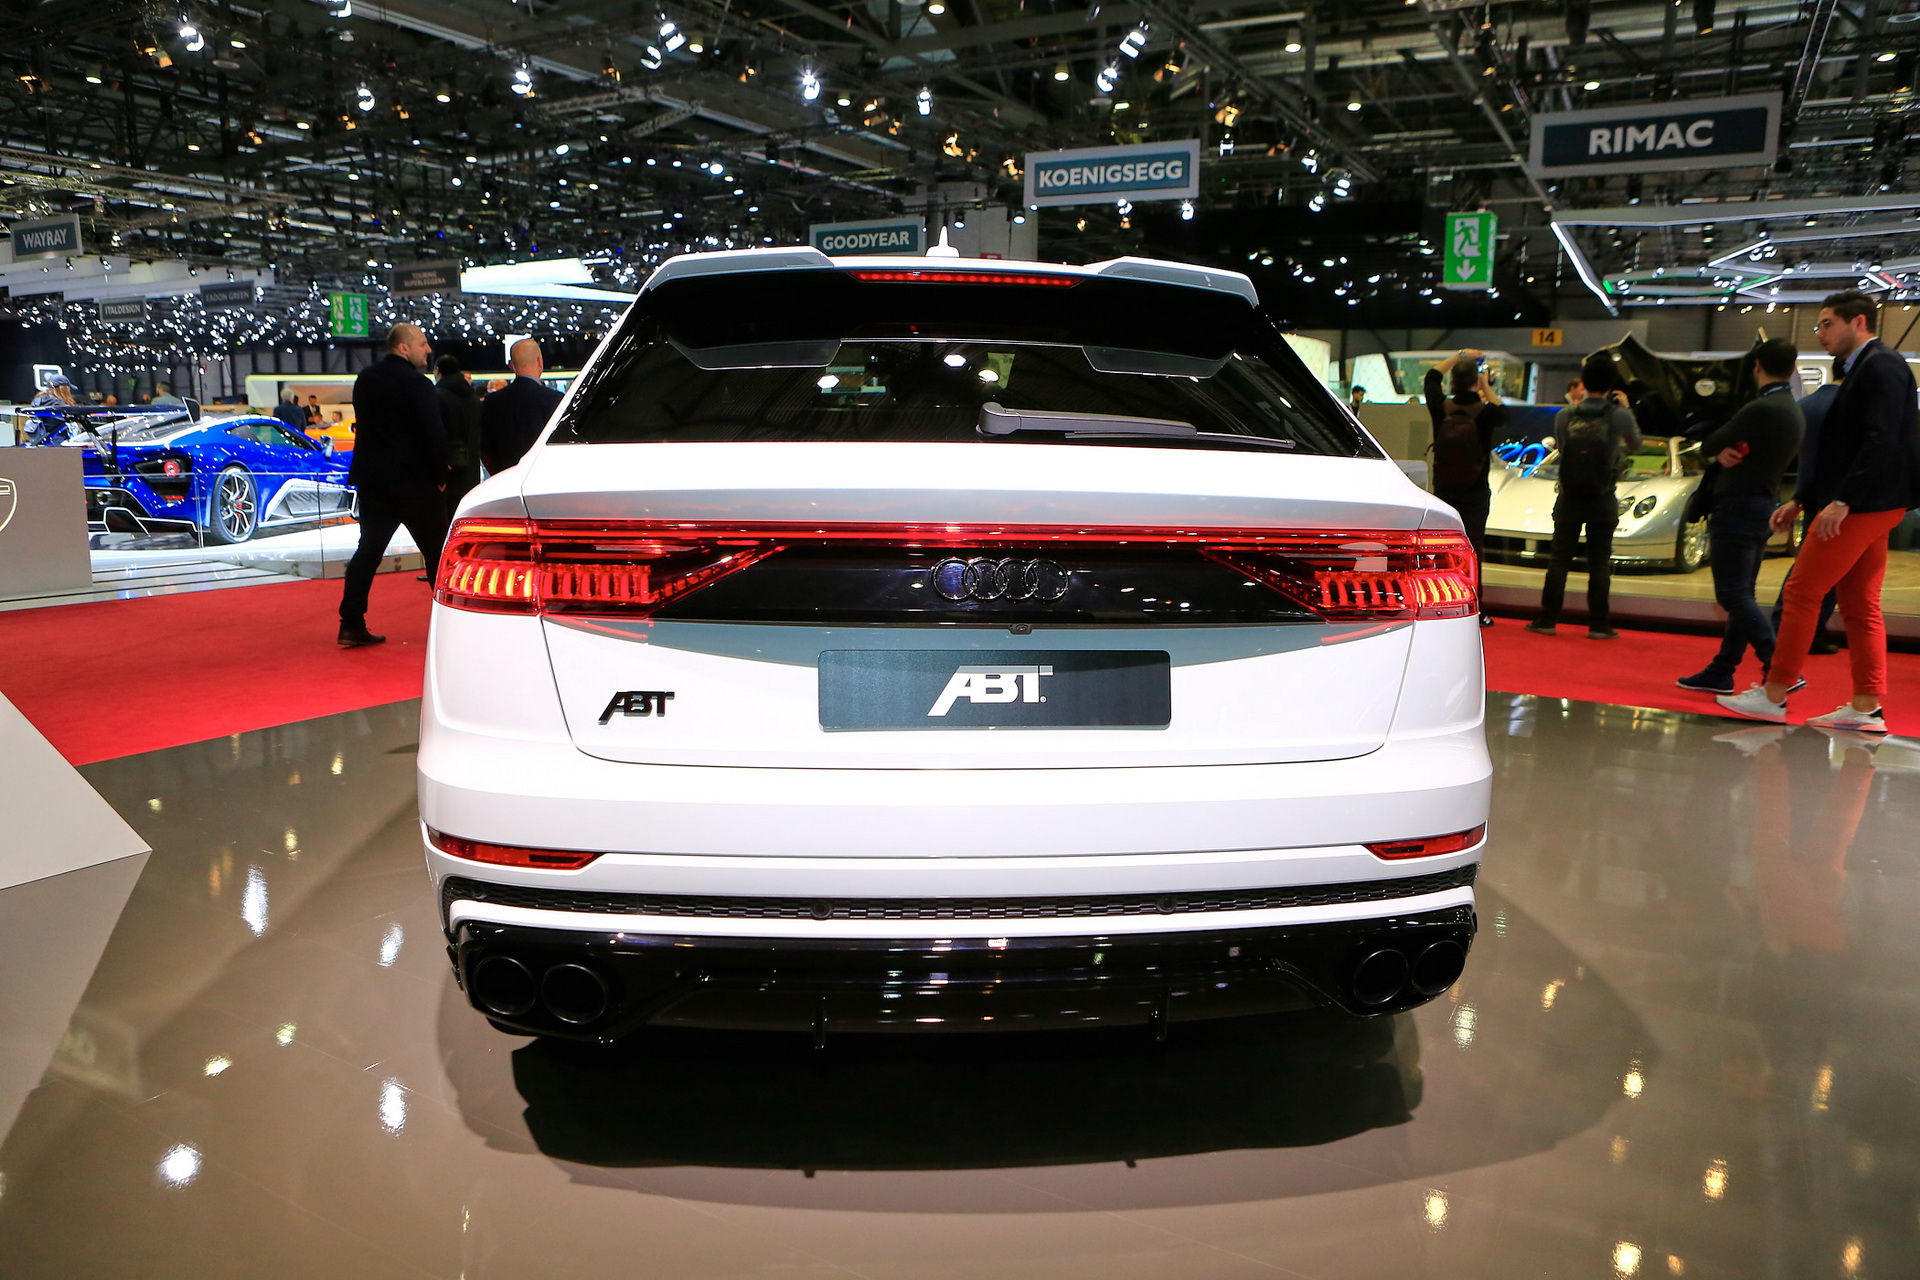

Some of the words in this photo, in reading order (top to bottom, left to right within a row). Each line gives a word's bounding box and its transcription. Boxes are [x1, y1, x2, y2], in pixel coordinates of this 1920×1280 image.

[1588, 119, 1715, 155] RIMAC
[1039, 160, 1183, 188] KOENIGSEGG
[22, 228, 68, 249] WAYRAY
[822, 231, 910, 250] GOODYEAR
[229, 291, 250, 300] GREEN
[105, 303, 141, 316] ITALDESIGN
[1539, 331, 1555, 344] 14
[927, 665, 1054, 717] ABT
[598, 691, 675, 725] ABT
